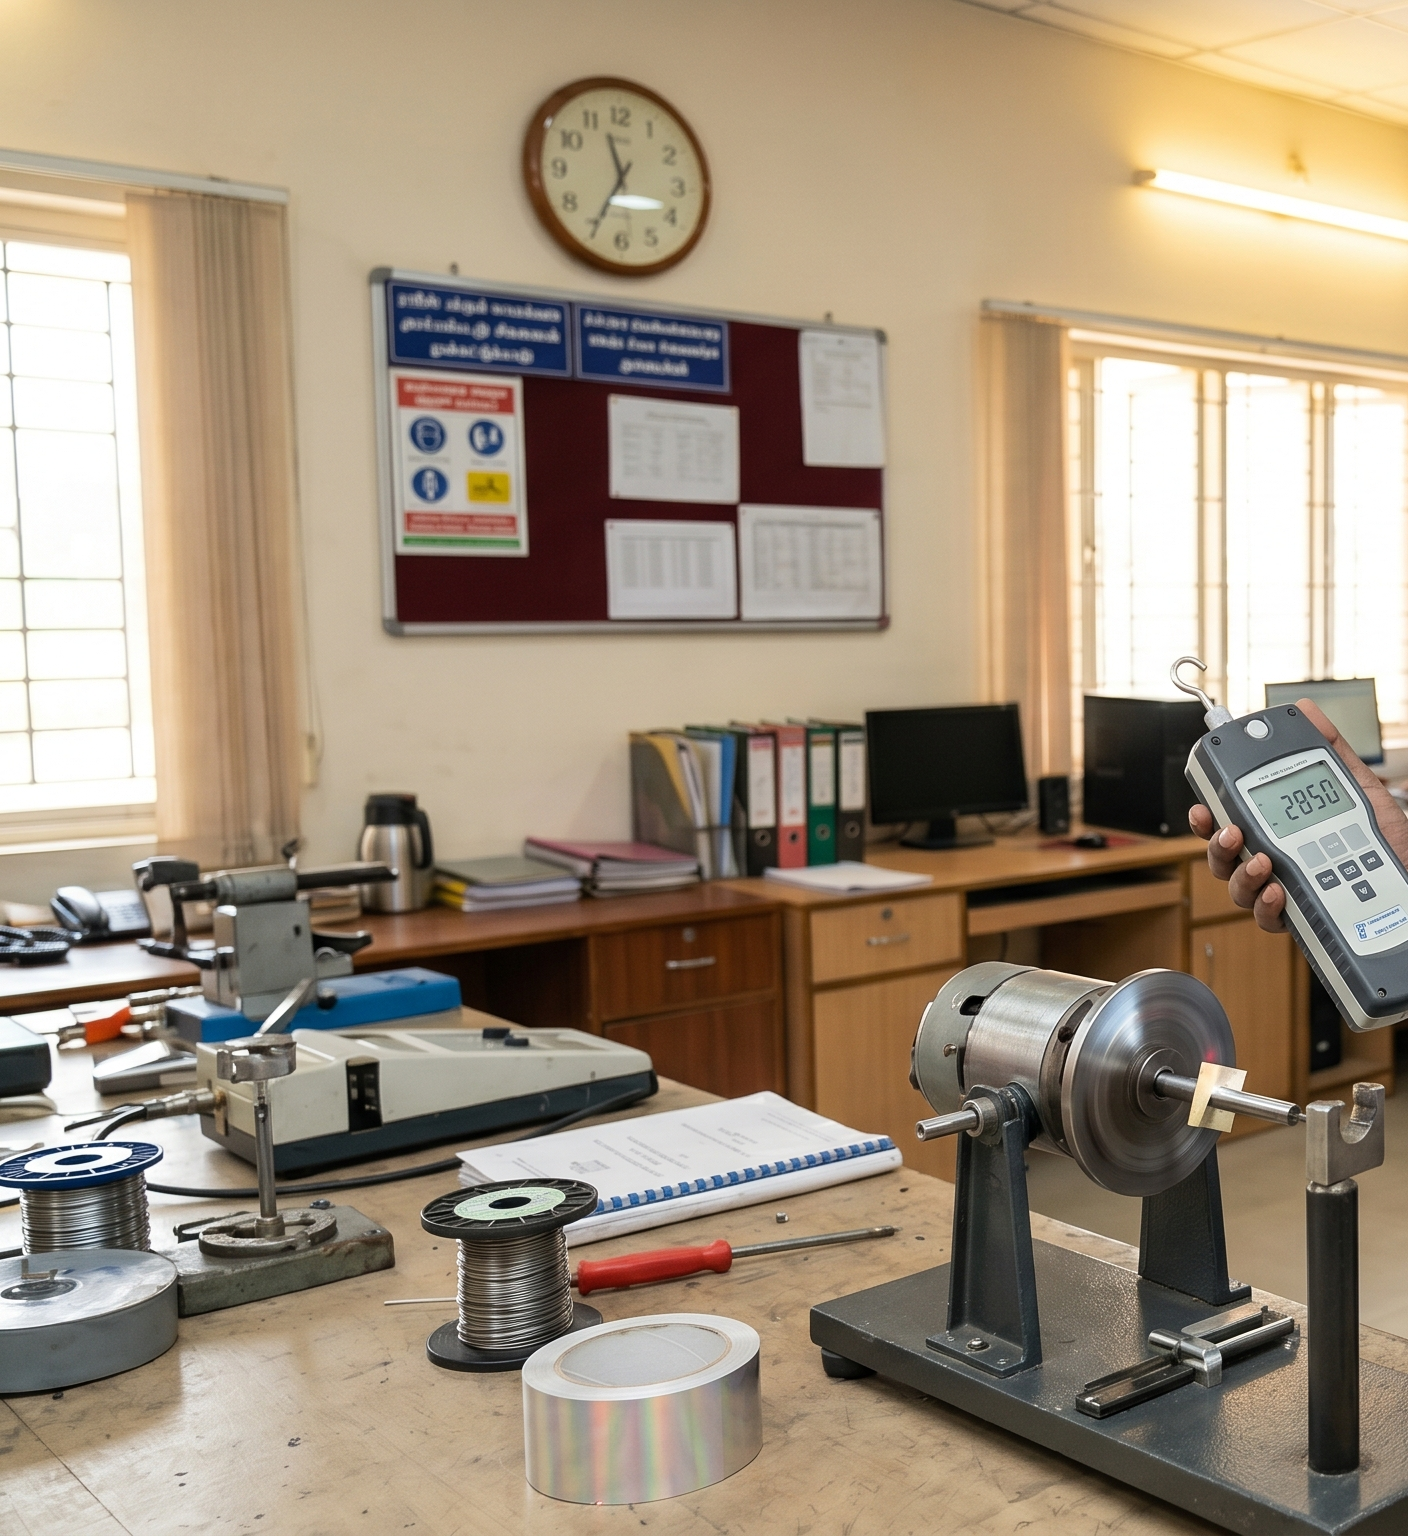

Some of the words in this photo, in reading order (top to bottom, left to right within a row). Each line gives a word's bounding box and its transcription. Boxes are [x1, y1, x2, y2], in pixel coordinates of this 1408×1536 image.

[582, 109, 599, 131] 11
[610, 106, 631, 127] 12
[560, 129, 583, 151] 10
[646, 120, 654, 139] 1
[662, 145, 677, 166] 2
[551, 157, 568, 179] 9
[670, 176, 686, 198] 3
[562, 191, 578, 213] 8
[586, 217, 602, 240] 7
[663, 208, 677, 227] 4
[613, 231, 630, 251] 6
[644, 227, 659, 247] 5
[1280, 779, 1340, 820] 2850
